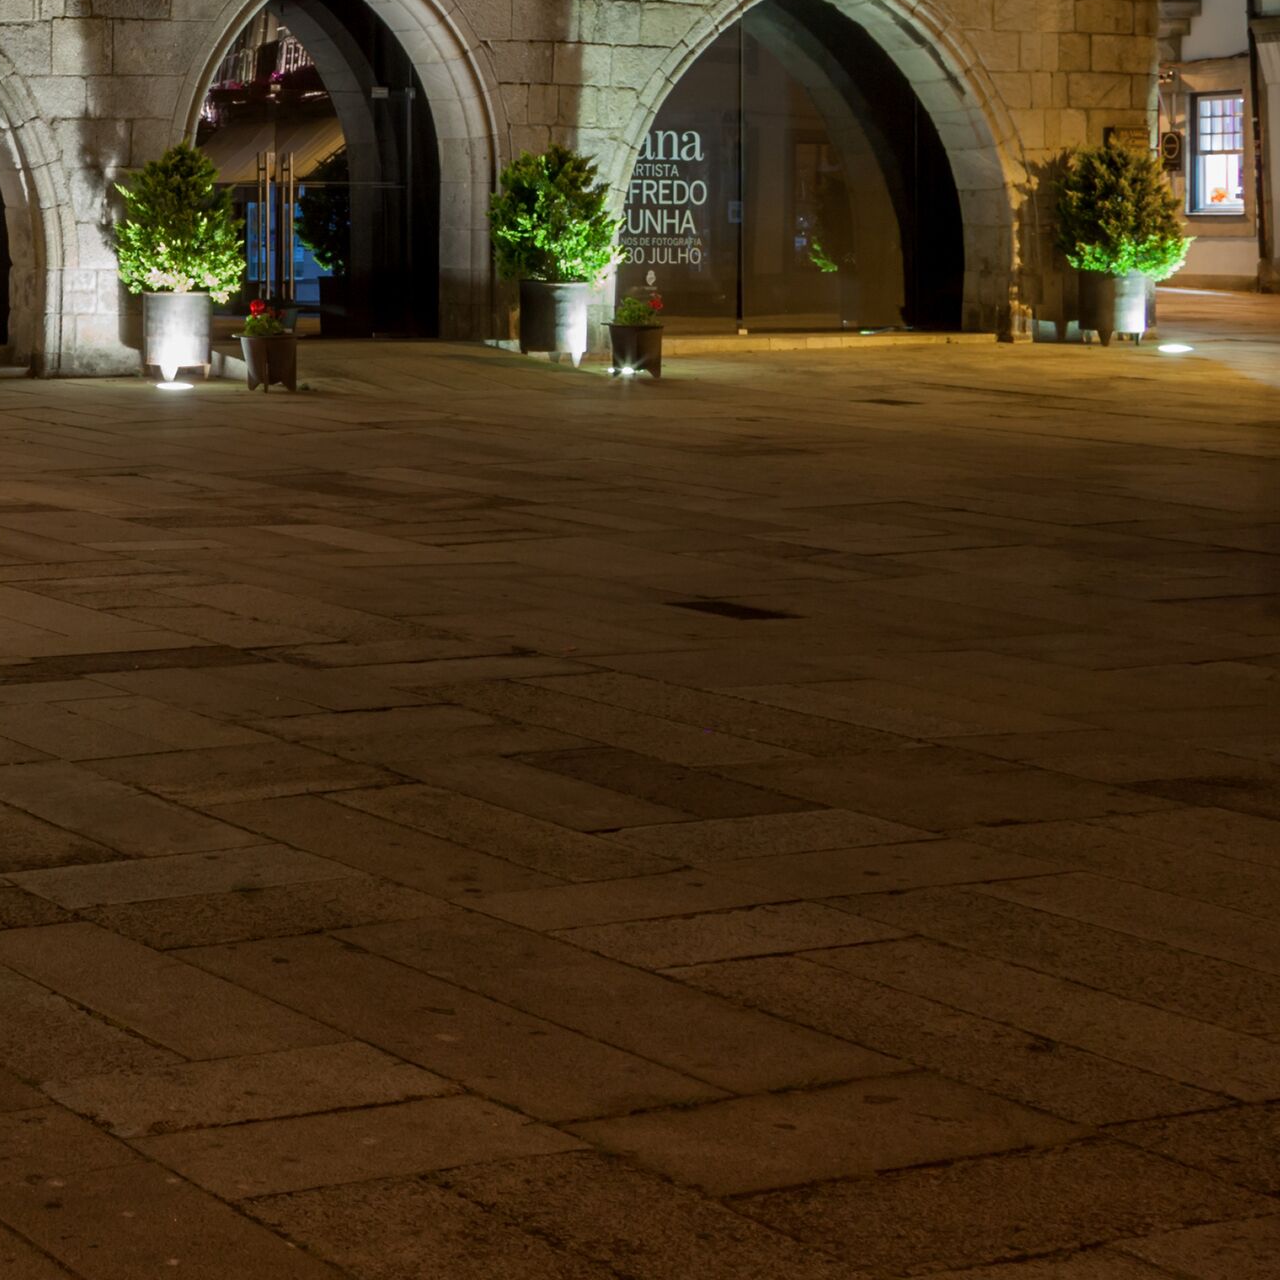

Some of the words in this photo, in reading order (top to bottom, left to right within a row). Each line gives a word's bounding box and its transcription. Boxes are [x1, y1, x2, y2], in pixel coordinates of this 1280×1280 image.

[637, 130, 704, 161] ana
[624, 179, 707, 206] FREDO
[640, 237, 650, 246] DE
[652, 237, 702, 246] FOTOGRAFIA
[647, 247, 702, 264] JULHO
